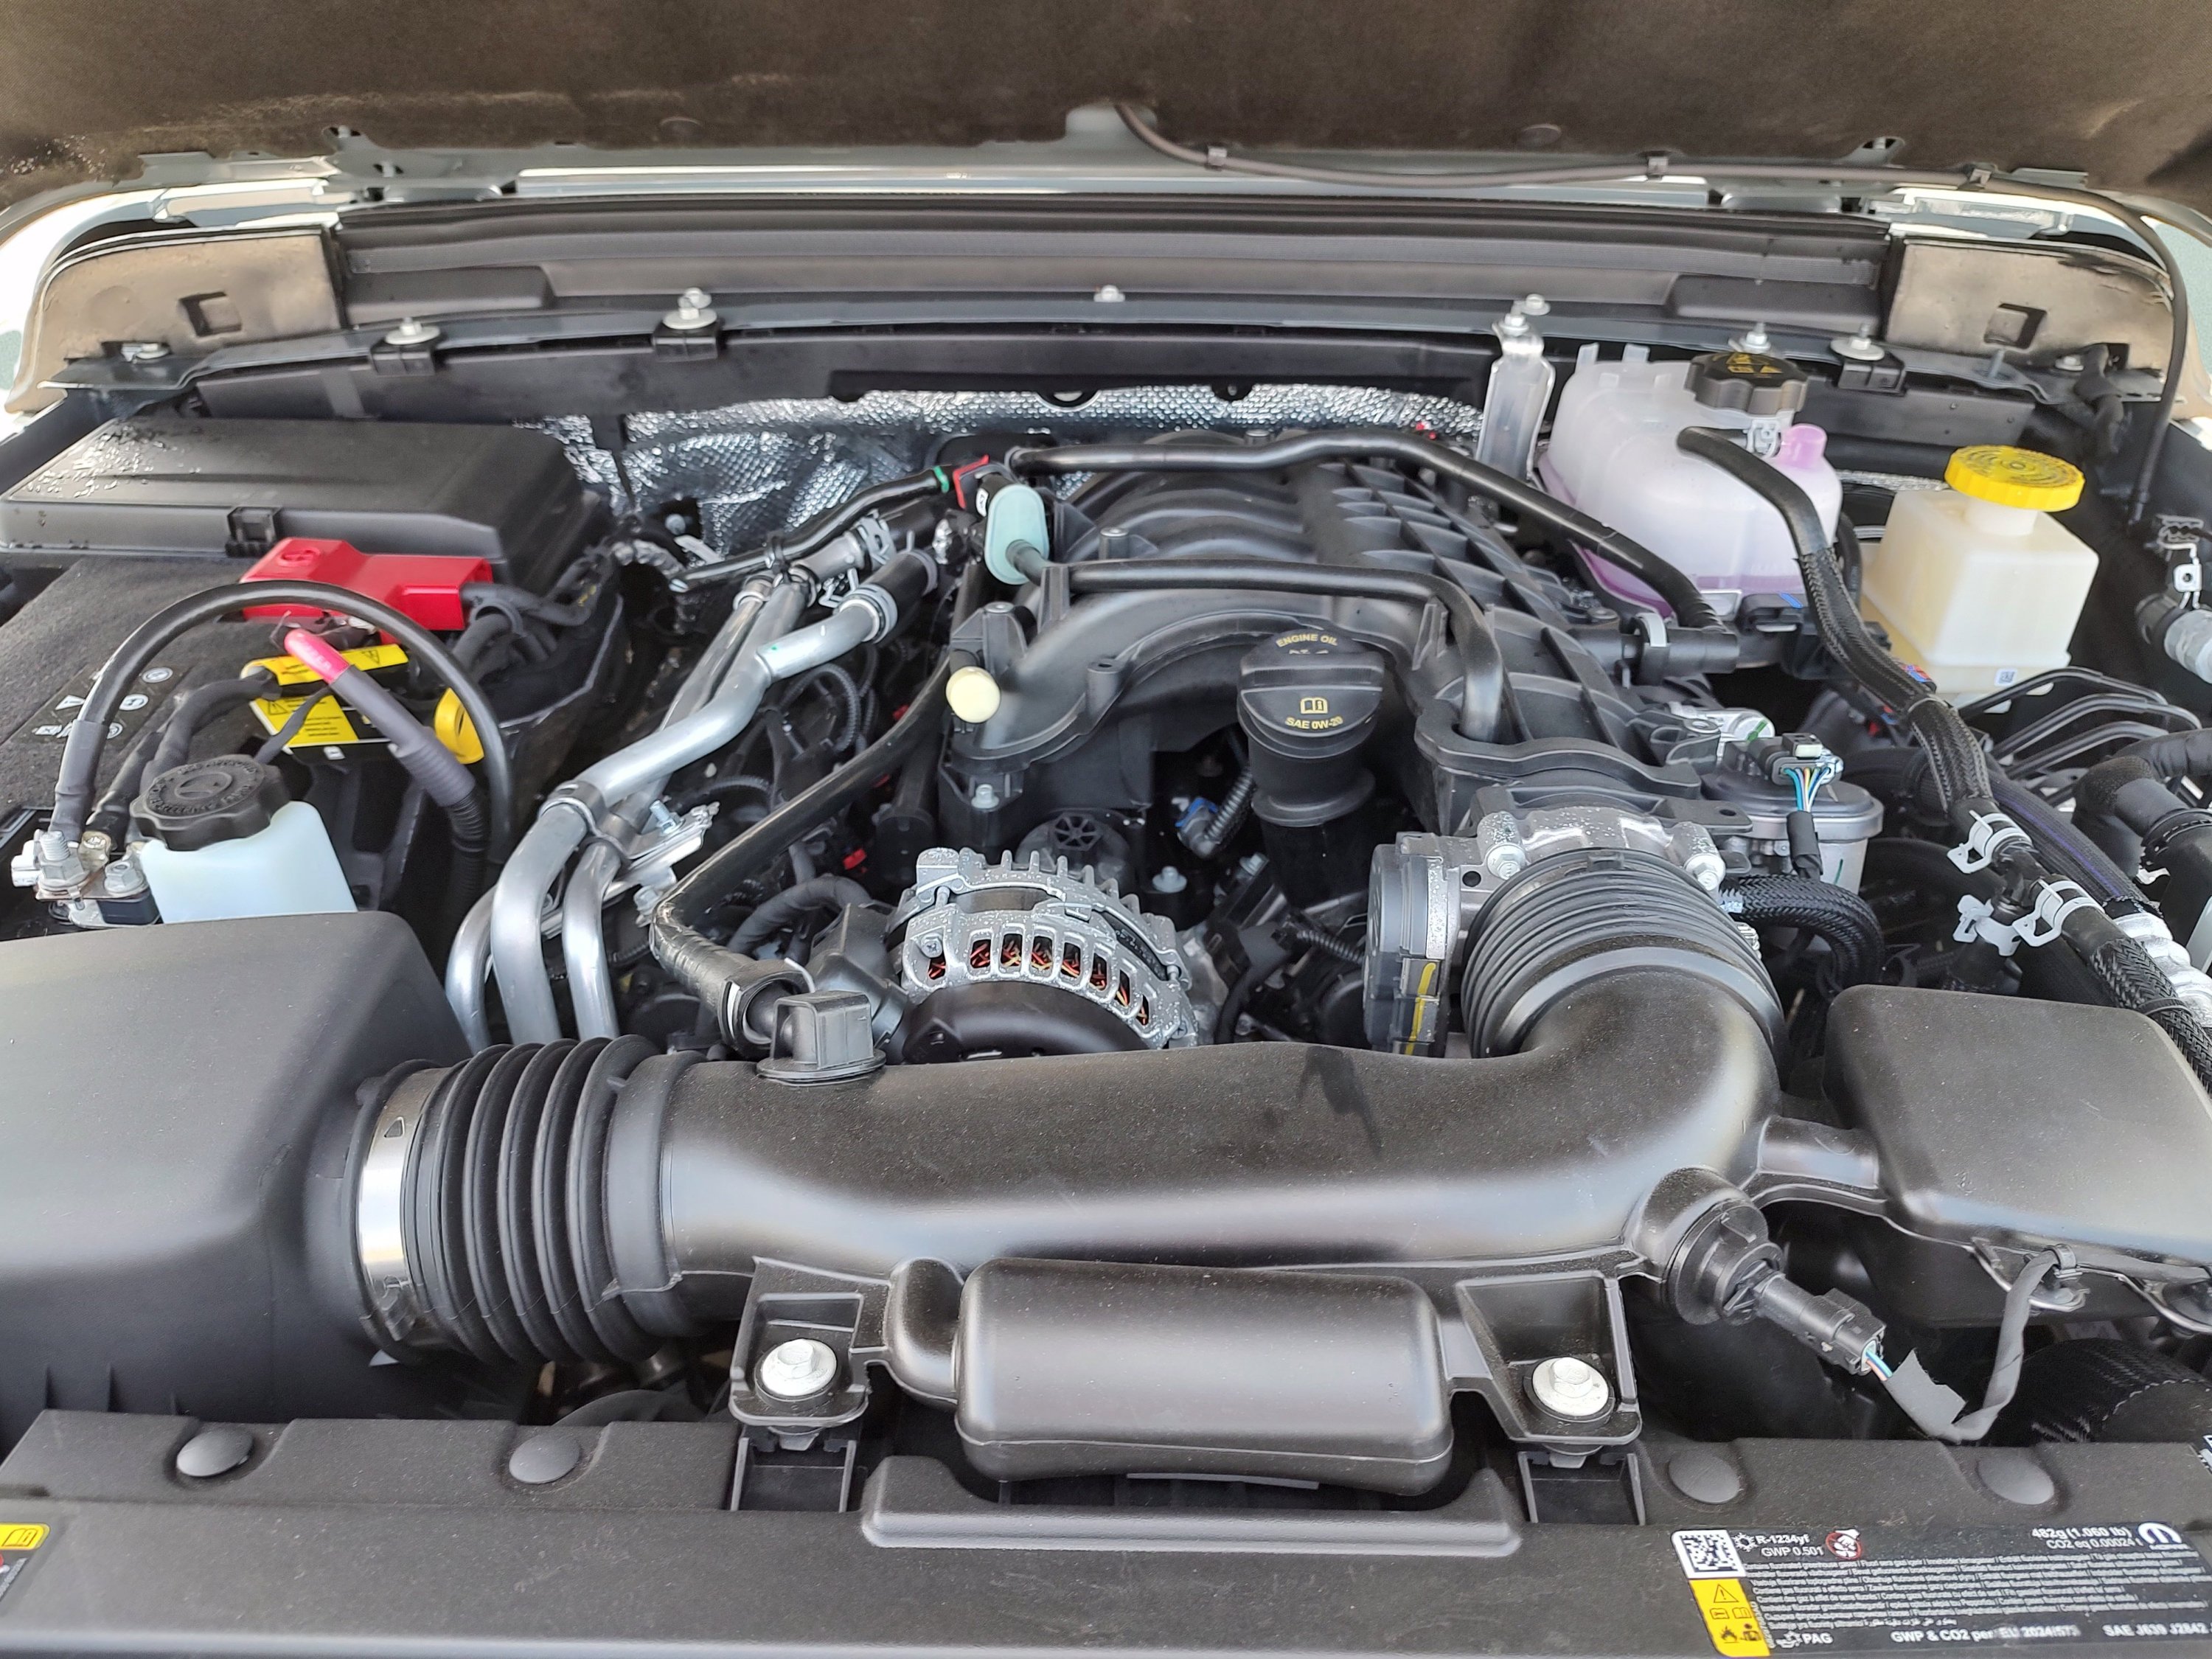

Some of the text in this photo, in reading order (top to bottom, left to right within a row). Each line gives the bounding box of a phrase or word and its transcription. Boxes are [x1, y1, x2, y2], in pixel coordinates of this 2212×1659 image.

[1276, 633, 1338, 647] ENGINE OIL
[1284, 716, 1343, 729] SAE 0W-20
[2110, 1526, 2133, 1538] lb)
[1756, 1534, 1811, 1545] R-1234yf
[2046, 1539, 2074, 1550] CO2
[2074, 1540, 2091, 1550] eq
[1761, 1545, 1824, 1557] GWP 0.501
[1891, 1630, 1924, 1643] GWP
[1927, 1630, 1939, 1642] &
[1940, 1629, 1970, 1642] CO2
[1971, 1630, 1993, 1642] per
[2102, 1624, 2135, 1637] SAE
[1801, 1633, 1834, 1644] PAG
